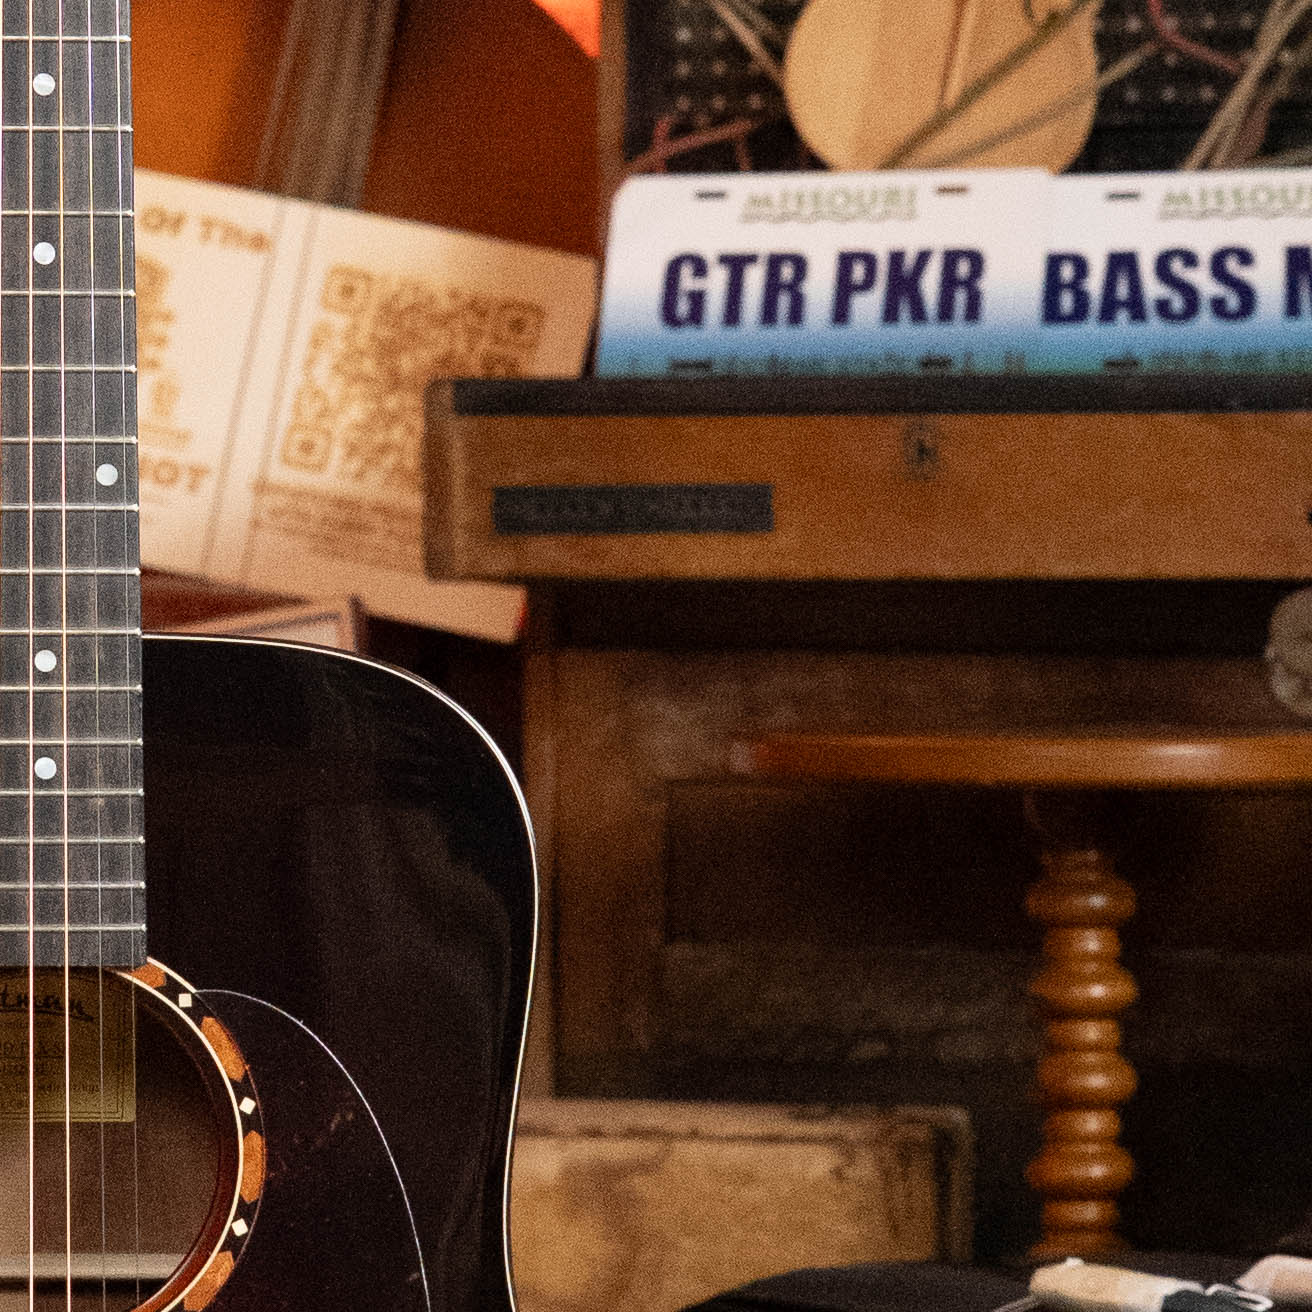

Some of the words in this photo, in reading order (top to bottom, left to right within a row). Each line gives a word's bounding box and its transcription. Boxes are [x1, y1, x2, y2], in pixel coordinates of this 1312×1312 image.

[740, 185, 919, 221] MISSOURI
[1158, 184, 1312, 218] MISSOU
[660, 251, 809, 328] GTR
[831, 248, 986, 326] PKR
[1041, 246, 1258, 325] BASS
